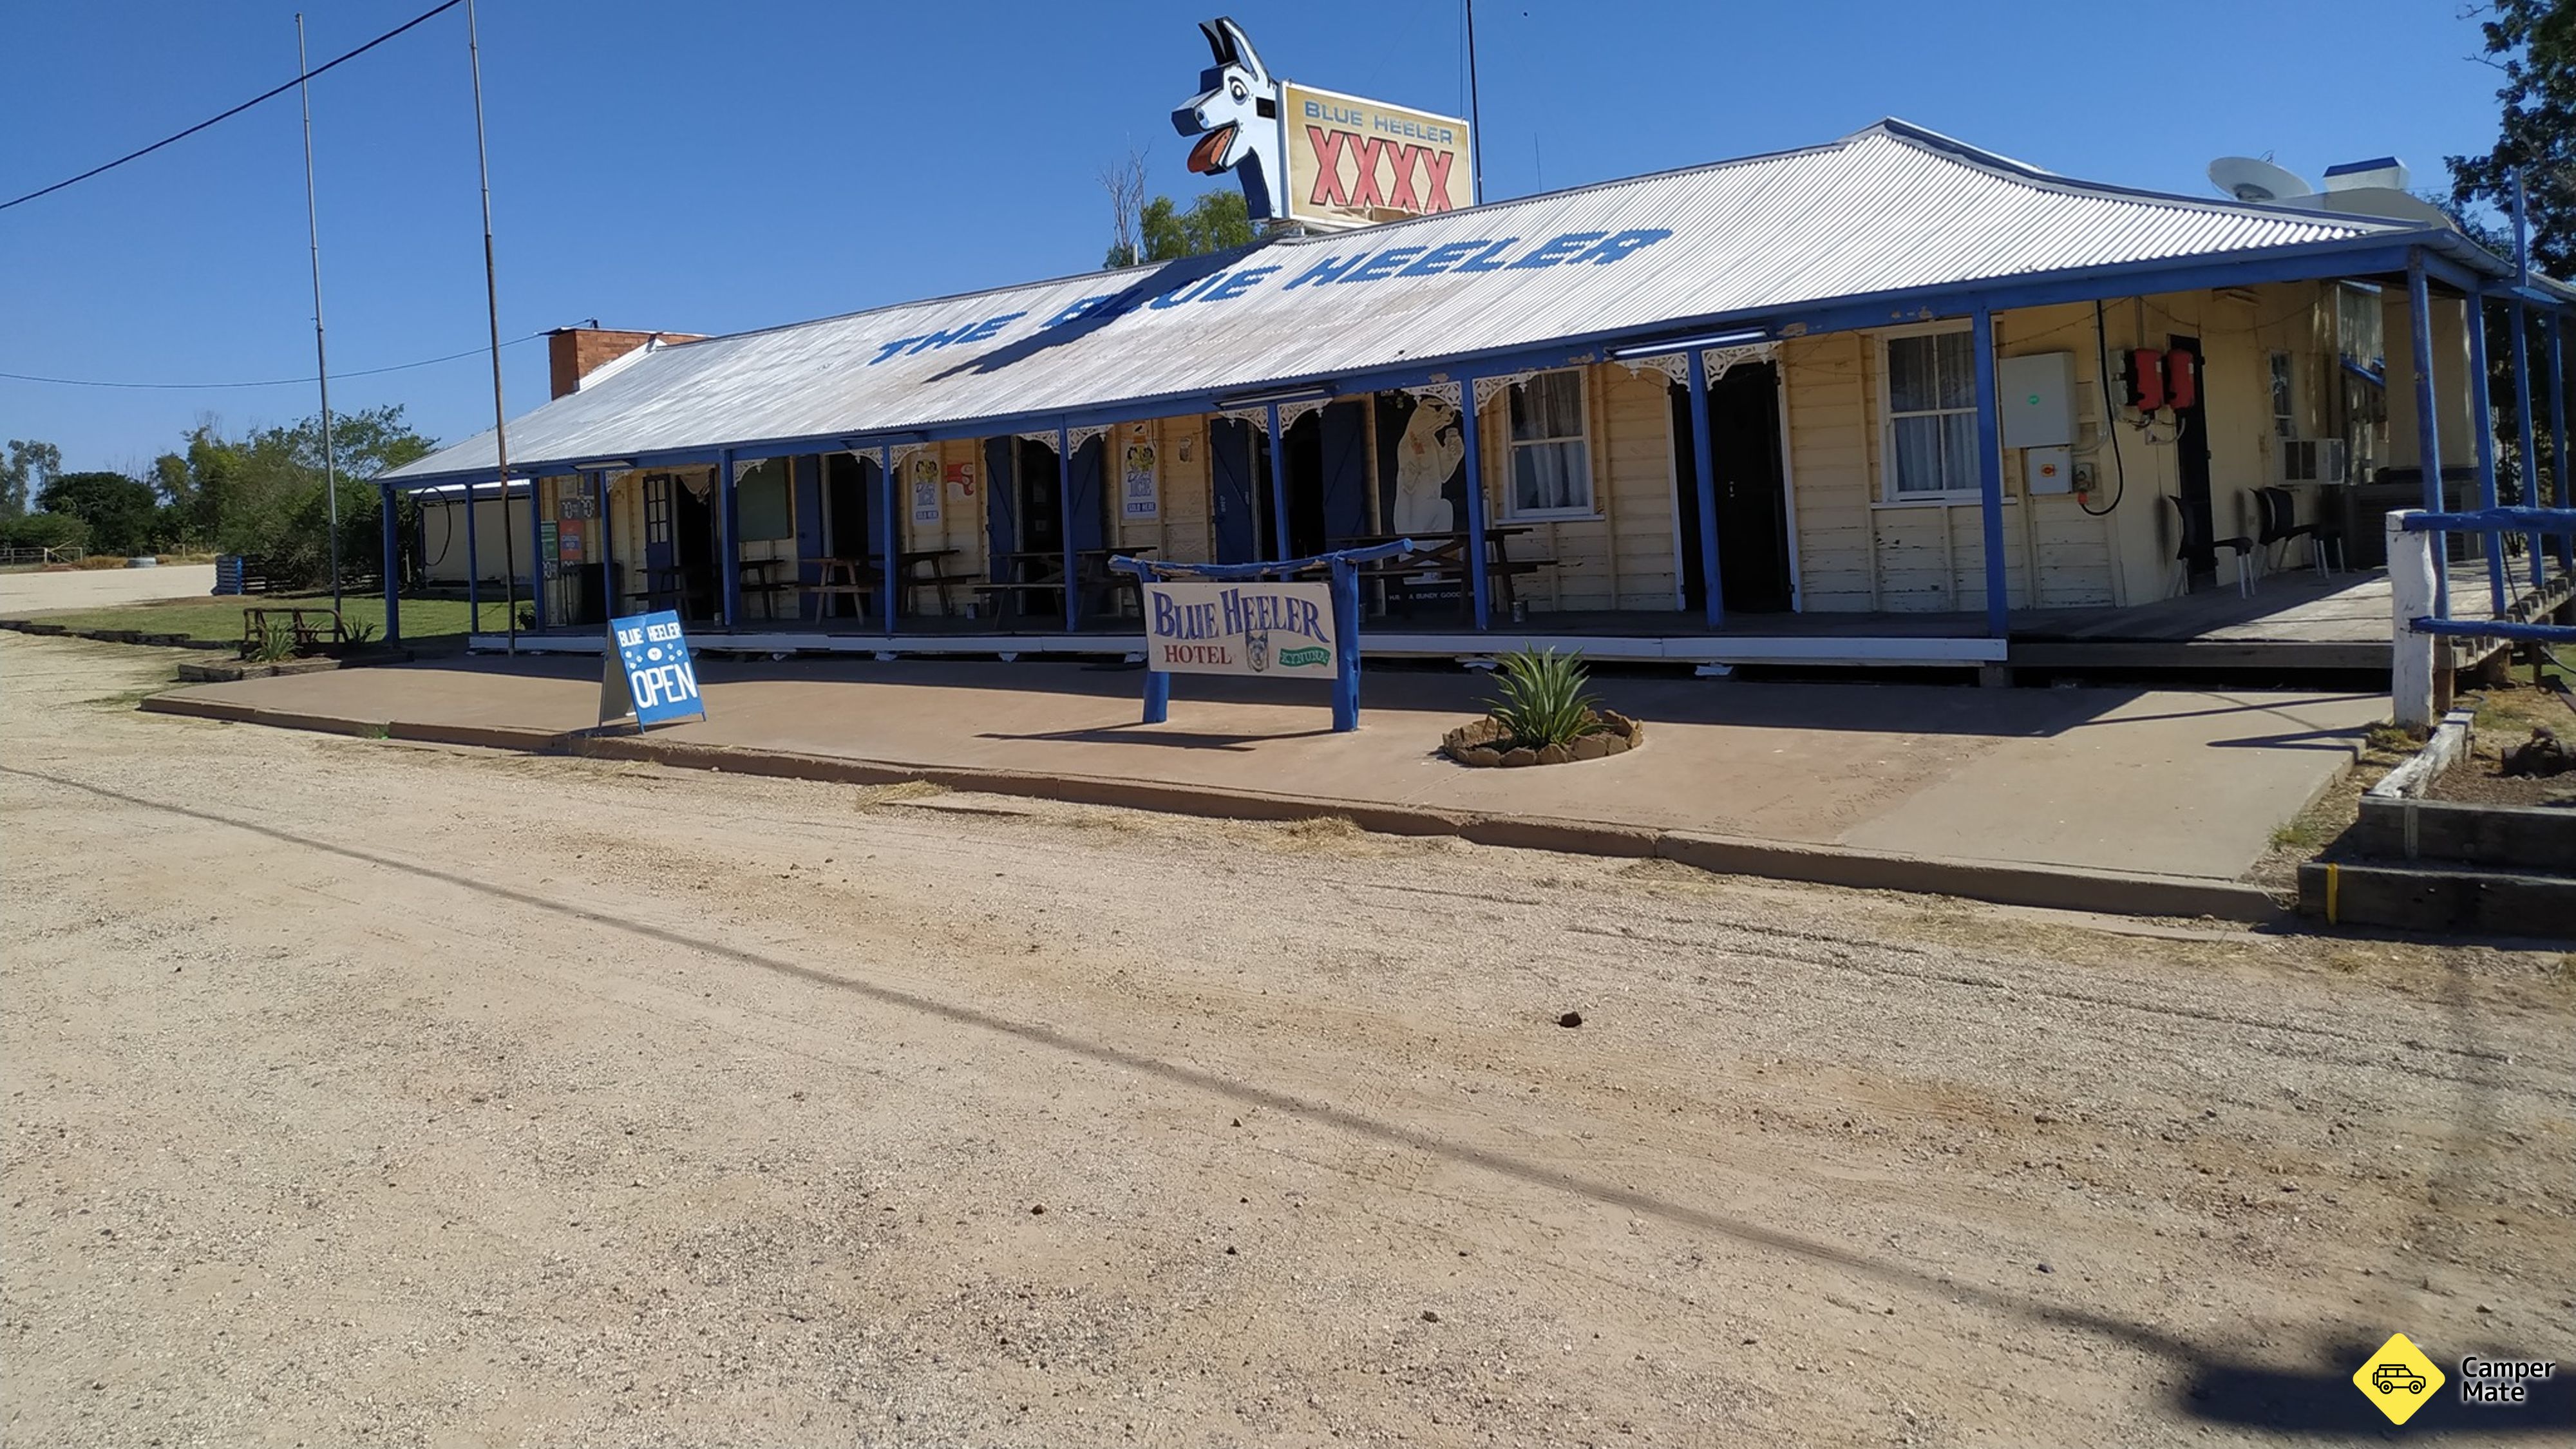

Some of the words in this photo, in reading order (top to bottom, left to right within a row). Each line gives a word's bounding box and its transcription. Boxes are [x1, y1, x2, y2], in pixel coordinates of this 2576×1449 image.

[1305, 101, 1363, 127] BLUE
[1374, 115, 1453, 145] HEELER
[1305, 124, 1454, 214] XXXX
[868, 310, 1028, 366] THE
[1039, 265, 1283, 329] BLUE
[1282, 229, 1674, 291] HEELER
[618, 627, 644, 647] BLUE
[647, 622, 683, 642] HEELER
[1151, 591, 1219, 640] BLUE
[1220, 587, 1331, 643] HEELER
[1164, 645, 1232, 665] HOTEL
[630, 661, 698, 709] OPEN
